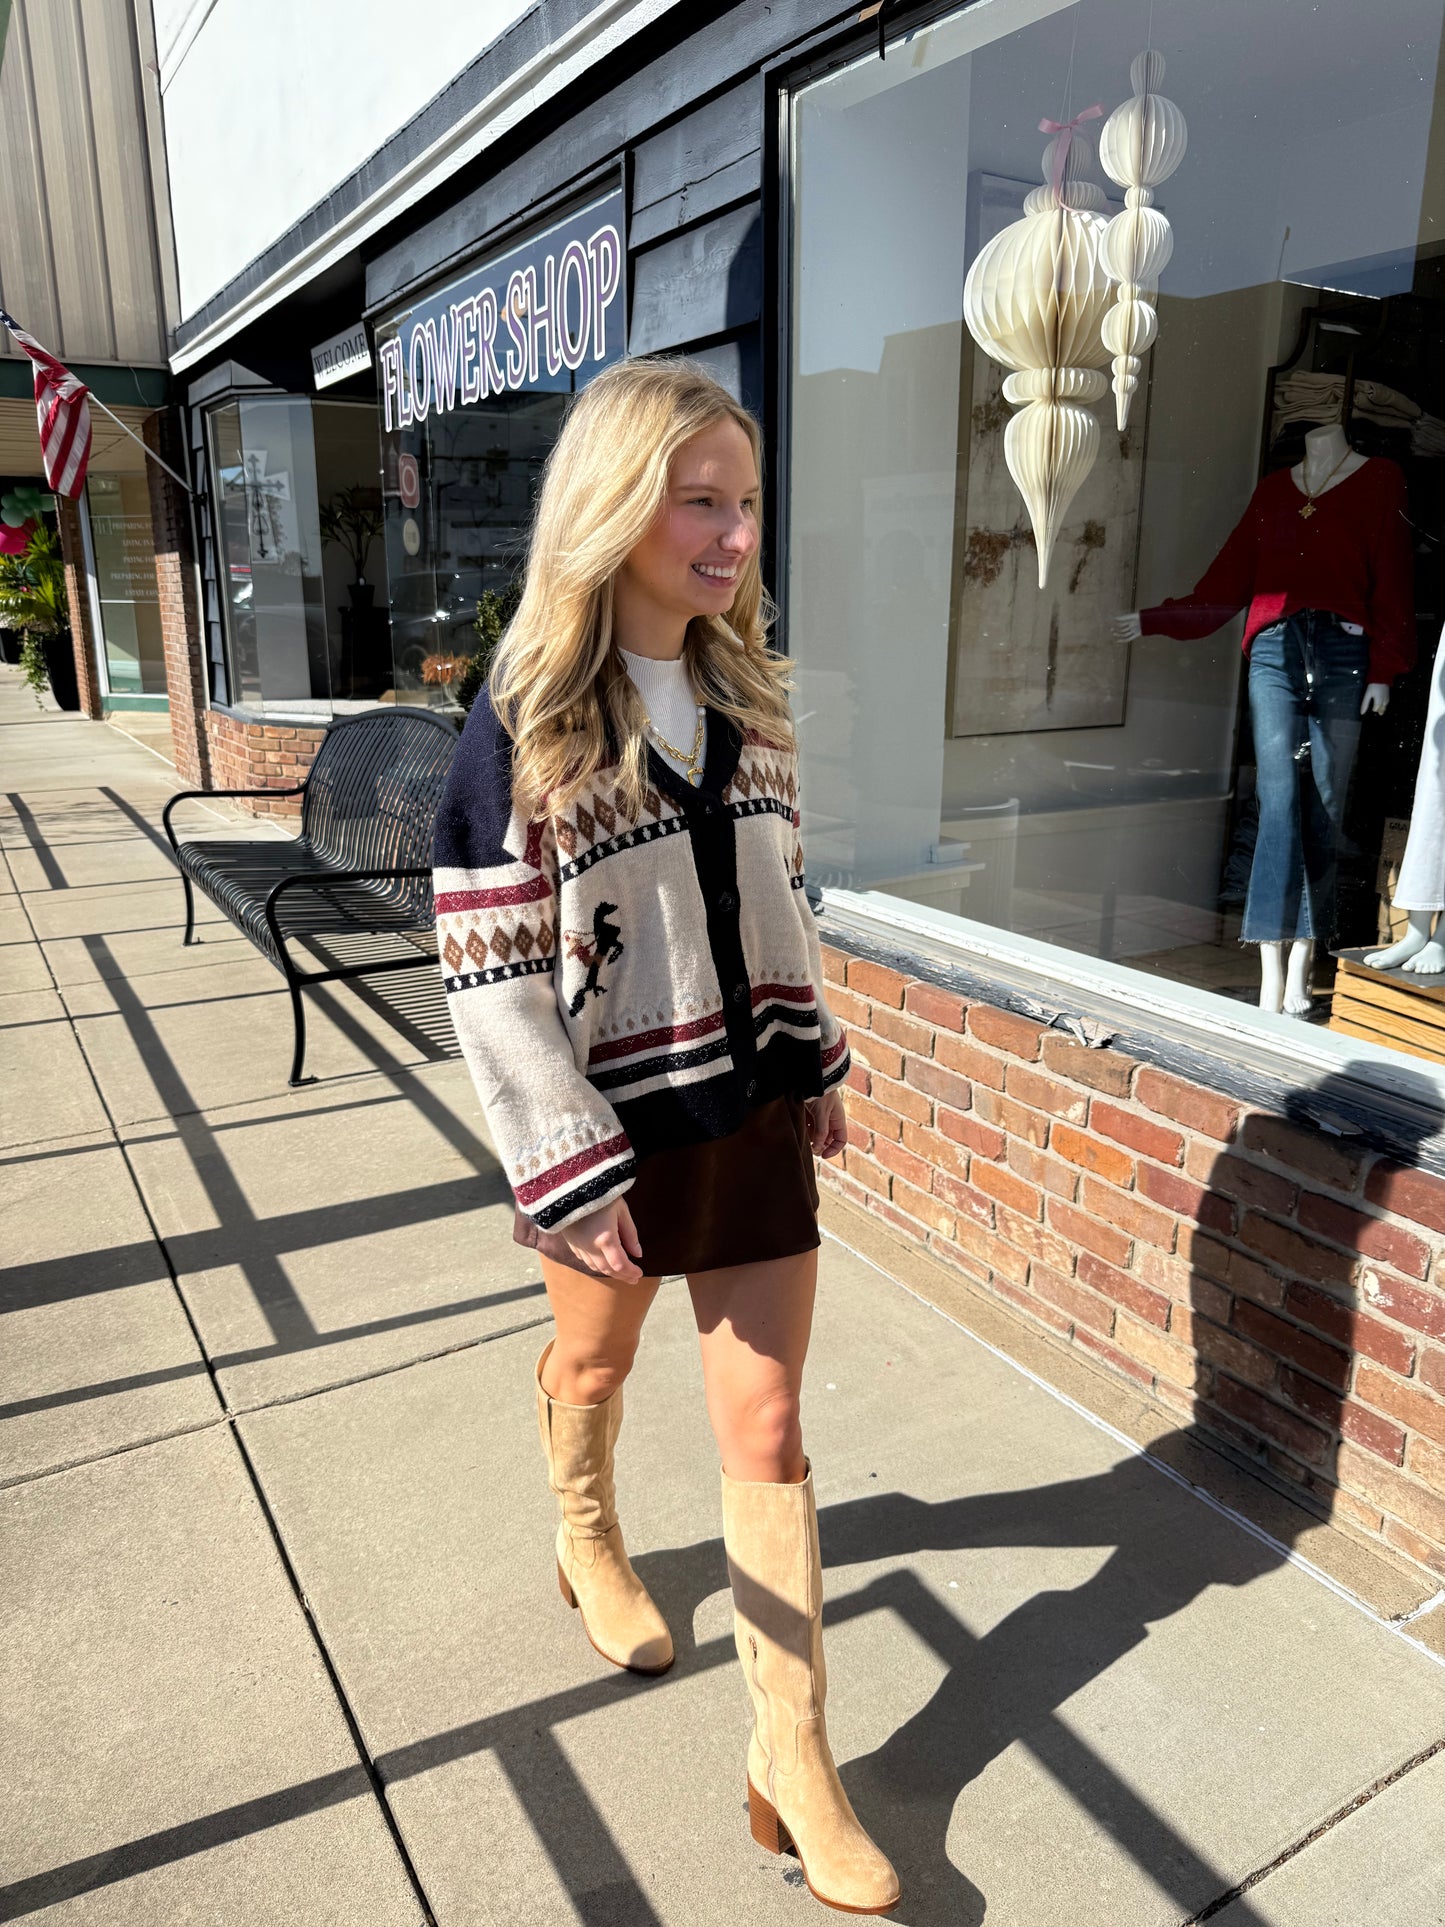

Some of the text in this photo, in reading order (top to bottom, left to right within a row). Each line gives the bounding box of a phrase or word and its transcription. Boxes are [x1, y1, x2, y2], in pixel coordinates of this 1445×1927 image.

[313, 332, 368, 379] WELCOME
[379, 224, 621, 432] FLOWER SHOP
